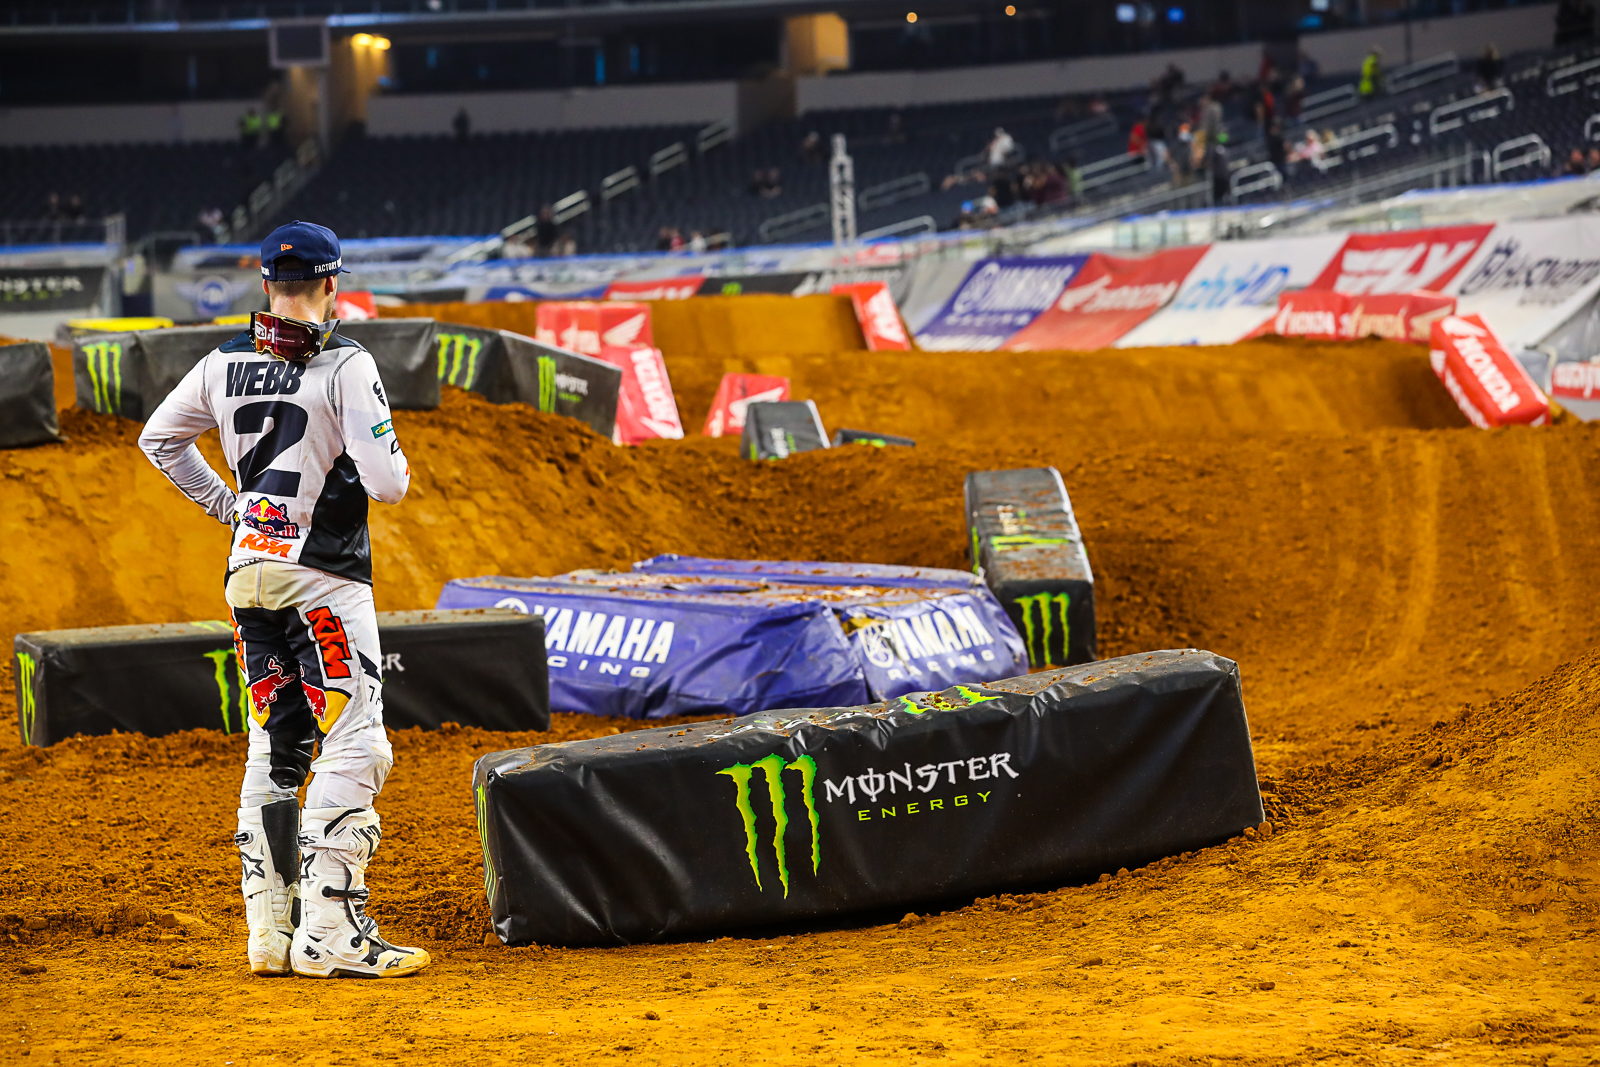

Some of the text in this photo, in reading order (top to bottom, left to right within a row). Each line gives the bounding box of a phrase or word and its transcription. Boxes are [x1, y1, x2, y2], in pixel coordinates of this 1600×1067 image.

[226, 361, 306, 397] WEBB
[1452, 336, 1521, 414] HONDA
[234, 400, 309, 498] 2
[238, 533, 293, 558] KTM
[305, 606, 353, 679] KTM
[534, 605, 675, 664] YAMAHA
[546, 655, 651, 678] CING
[823, 752, 1019, 804] MONSTER
[858, 790, 992, 821] ENERGY
